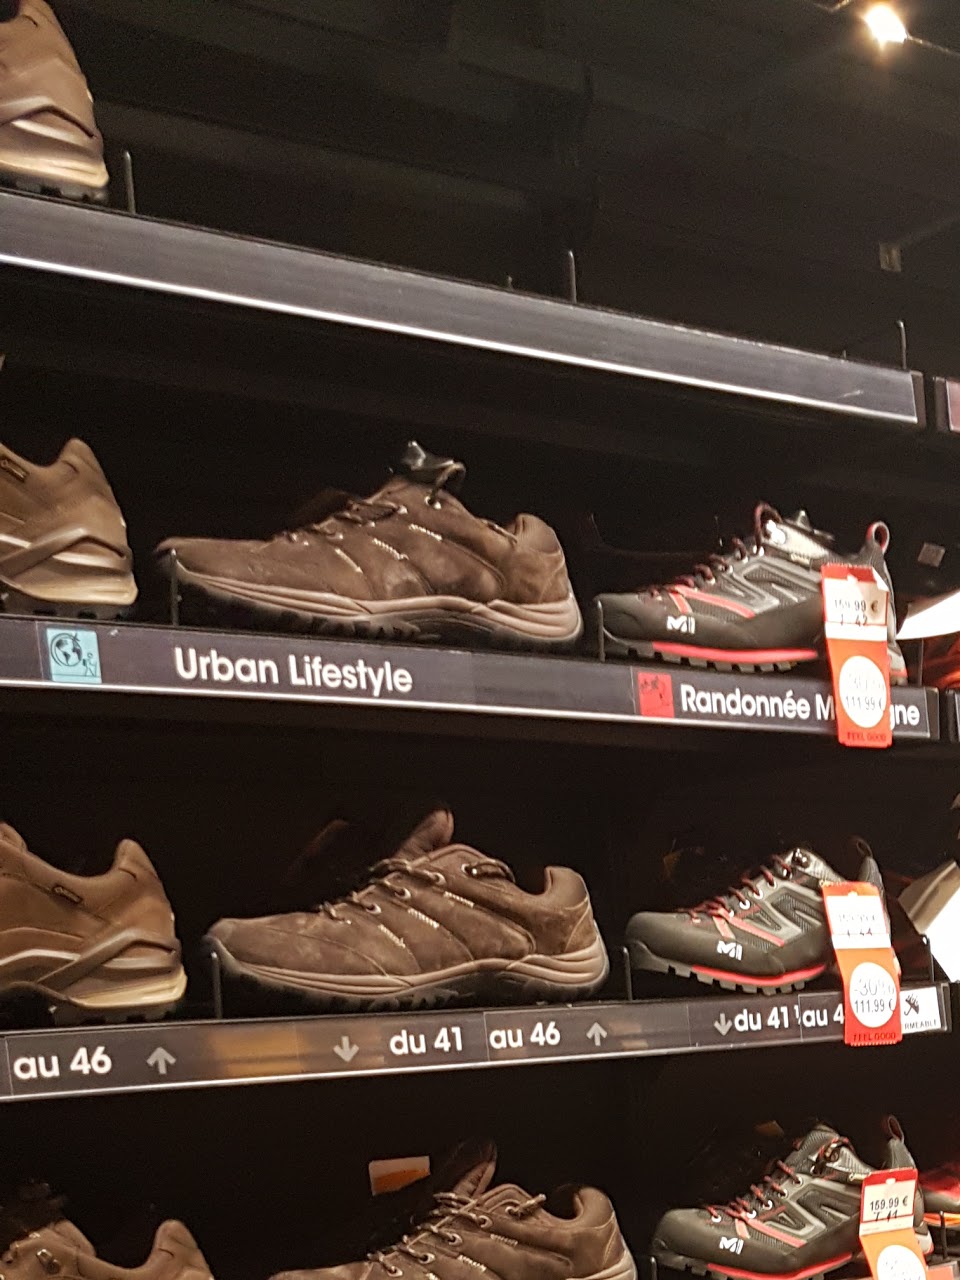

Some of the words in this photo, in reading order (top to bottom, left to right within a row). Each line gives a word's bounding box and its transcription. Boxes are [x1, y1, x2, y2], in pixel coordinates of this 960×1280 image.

[174, 646, 279, 684] Urban
[288, 654, 413, 698] Lifestyle
[680, 683, 811, 721] Randonnée
[734, 1008, 762, 1032] du
[767, 1006, 790, 1029] 41
[802, 1008, 828, 1027] au
[854, 999, 886, 1014] 111.99
[389, 1029, 427, 1055] du
[433, 1026, 464, 1052] 41
[489, 1027, 524, 1049] au
[528, 1021, 561, 1046] 46
[904, 1018, 938, 1031] RMEABLE
[13, 1055, 60, 1080] au
[70, 1045, 112, 1076] 46
[870, 1197, 900, 1211] 159.99
[902, 1195, 909, 1207] €
